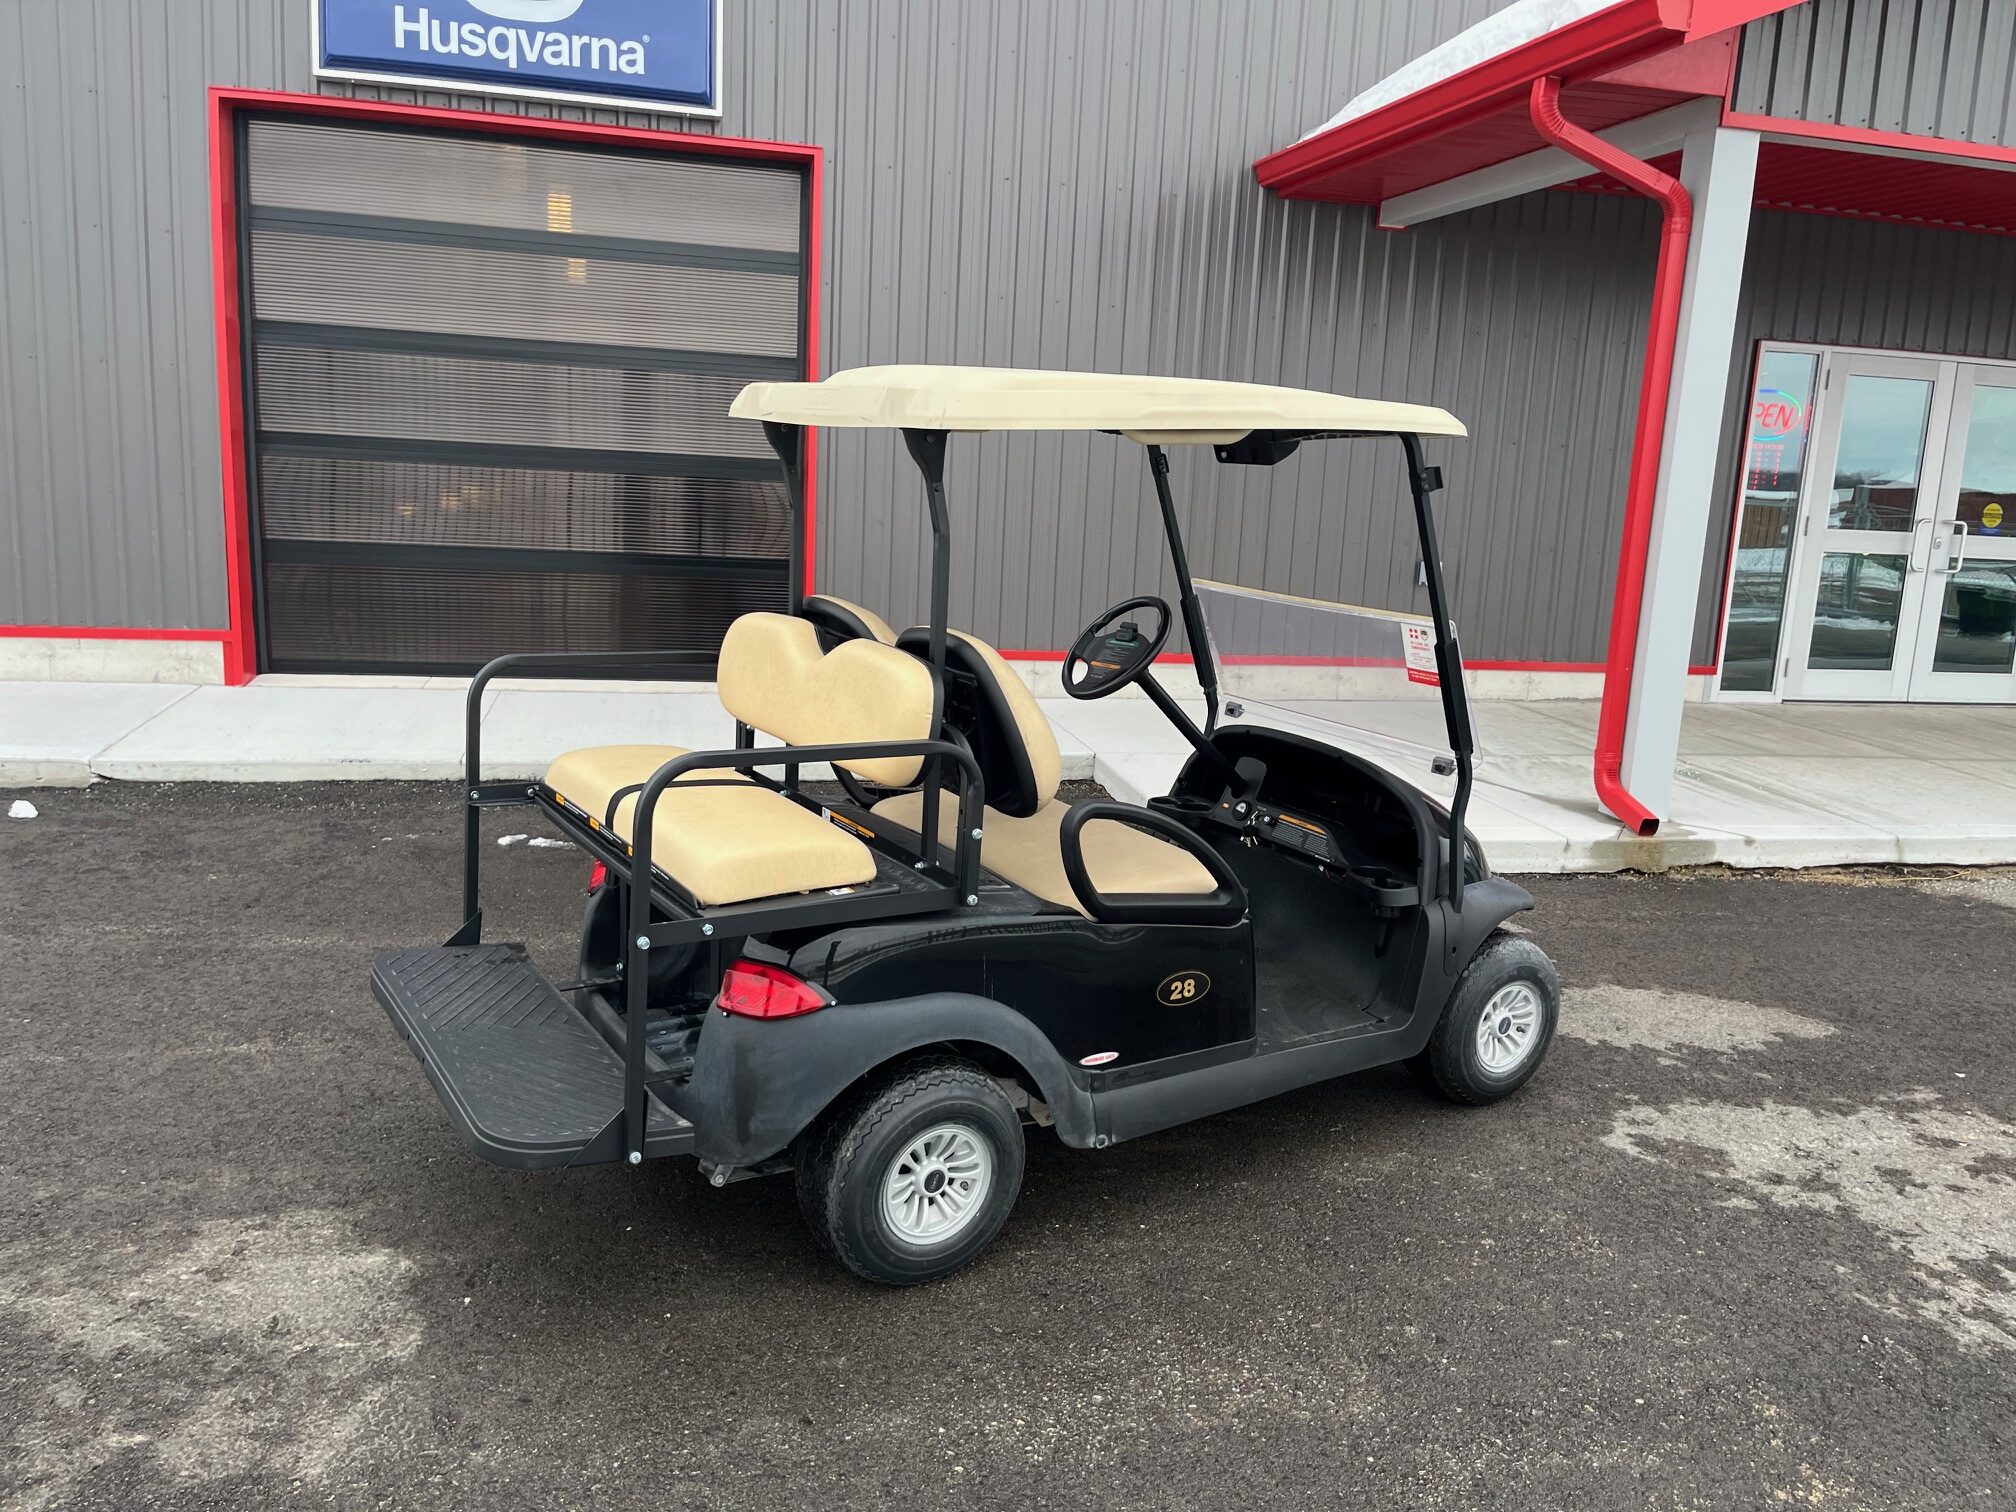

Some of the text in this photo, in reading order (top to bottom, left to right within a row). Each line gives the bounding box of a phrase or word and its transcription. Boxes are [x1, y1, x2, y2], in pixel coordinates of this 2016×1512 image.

[394, 5, 645, 75] Husqvarna
[1755, 402, 1795, 429] PEN
[1169, 978, 1196, 1001] 28
